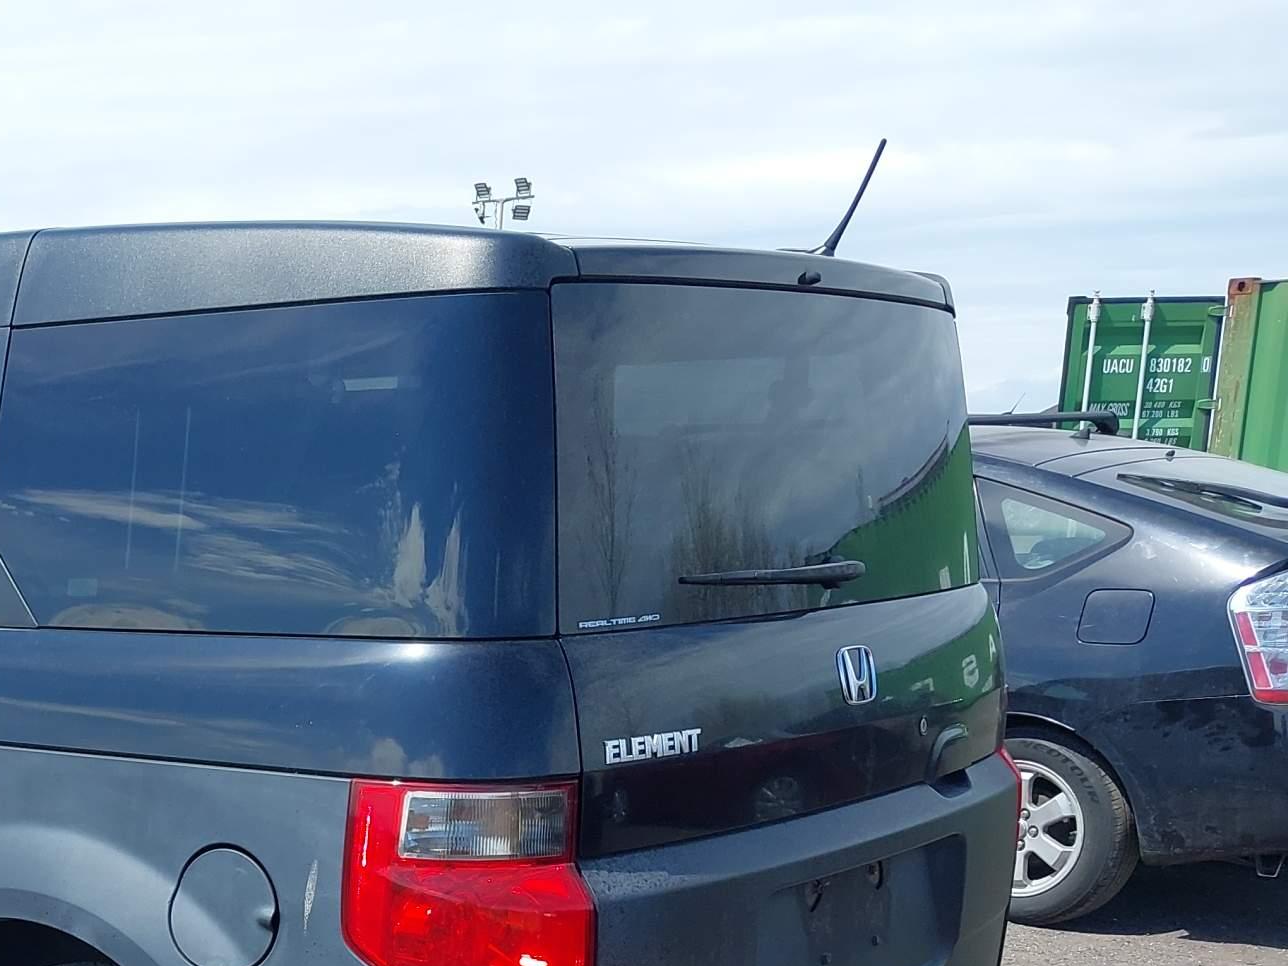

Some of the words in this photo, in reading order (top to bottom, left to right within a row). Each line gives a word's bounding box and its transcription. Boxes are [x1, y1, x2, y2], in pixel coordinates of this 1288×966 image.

[1102, 358, 1134, 374] UACU
[1149, 357, 1192, 373] 830182
[1146, 378, 1173, 393] 42G1
[603, 727, 701, 764] ELEMENT
